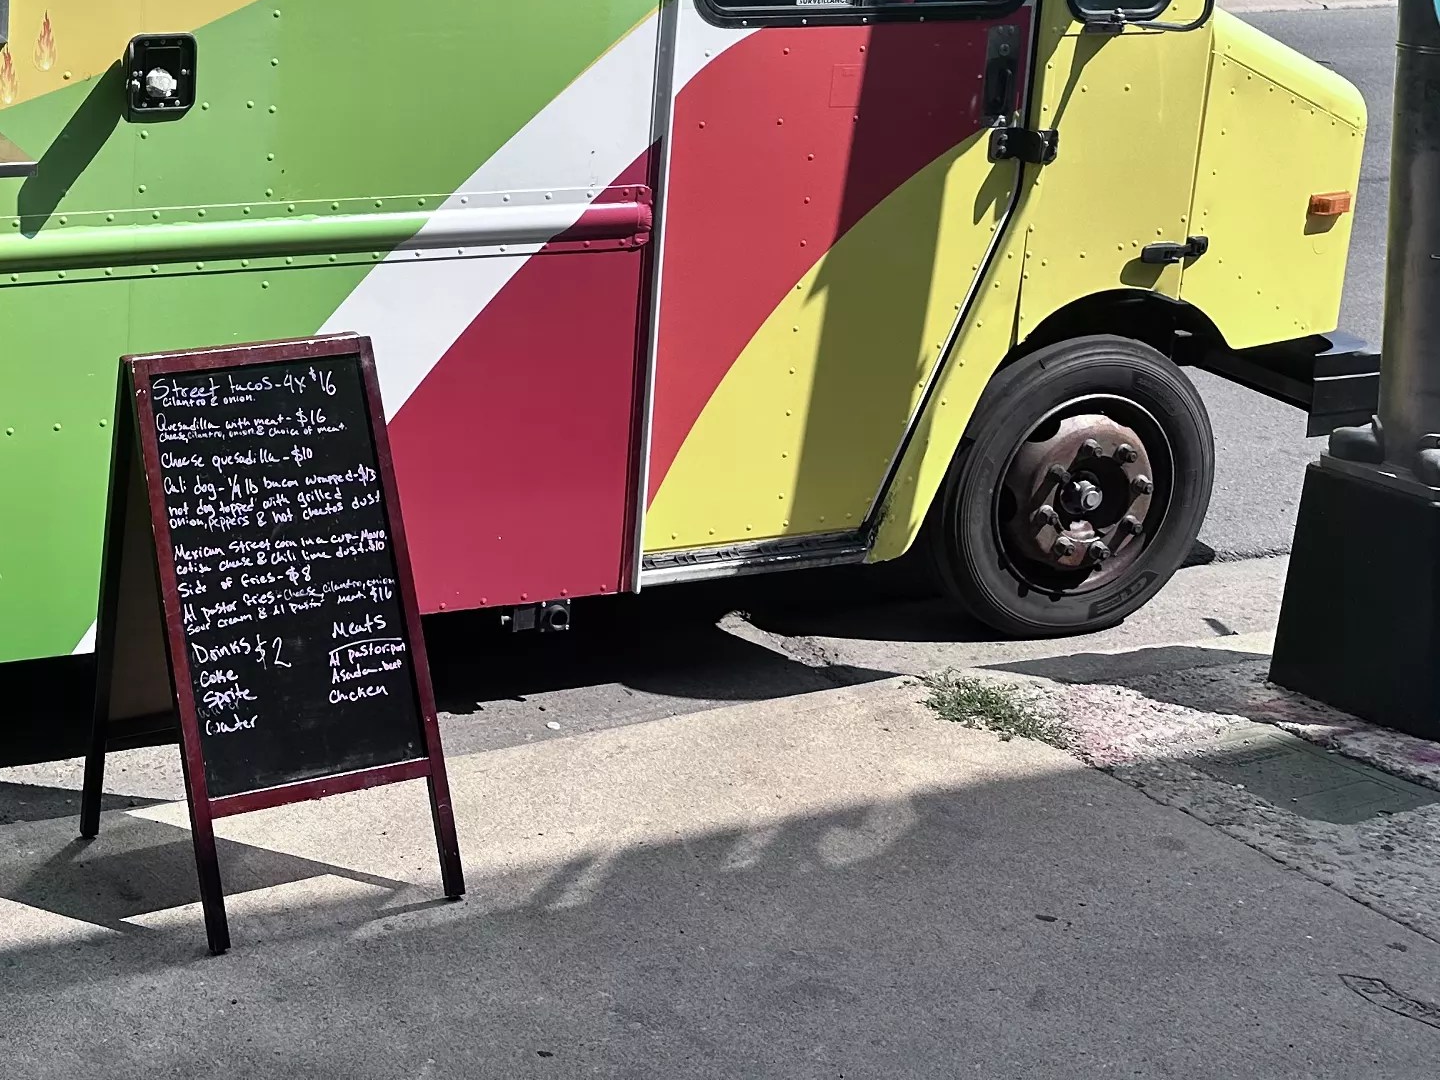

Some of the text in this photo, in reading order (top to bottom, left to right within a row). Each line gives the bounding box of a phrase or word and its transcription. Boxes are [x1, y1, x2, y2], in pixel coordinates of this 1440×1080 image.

[152, 377, 220, 400] Street
[156, 412, 221, 431] Quesadilla
[225, 417, 251, 429] with
[303, 425, 313, 436] of
[163, 475, 187, 495] Cali
[244, 478, 259, 495] lb
[262, 476, 299, 489] bacon
[196, 498, 216, 519] dog
[219, 497, 255, 518] topped
[297, 487, 343, 508] grilled
[256, 511, 267, 527] &
[351, 490, 381, 510] dust
[174, 543, 226, 561] Mexican
[274, 540, 298, 549] corn
[256, 551, 268, 565] &
[301, 549, 332, 561] lime
[177, 579, 207, 598] Side
[220, 576, 233, 590] of
[331, 613, 387, 639] Meats
[191, 636, 251, 664] Drinks
[199, 669, 239, 688] Coke
[202, 682, 258, 710] Sprite
[328, 685, 389, 704] Chicken
